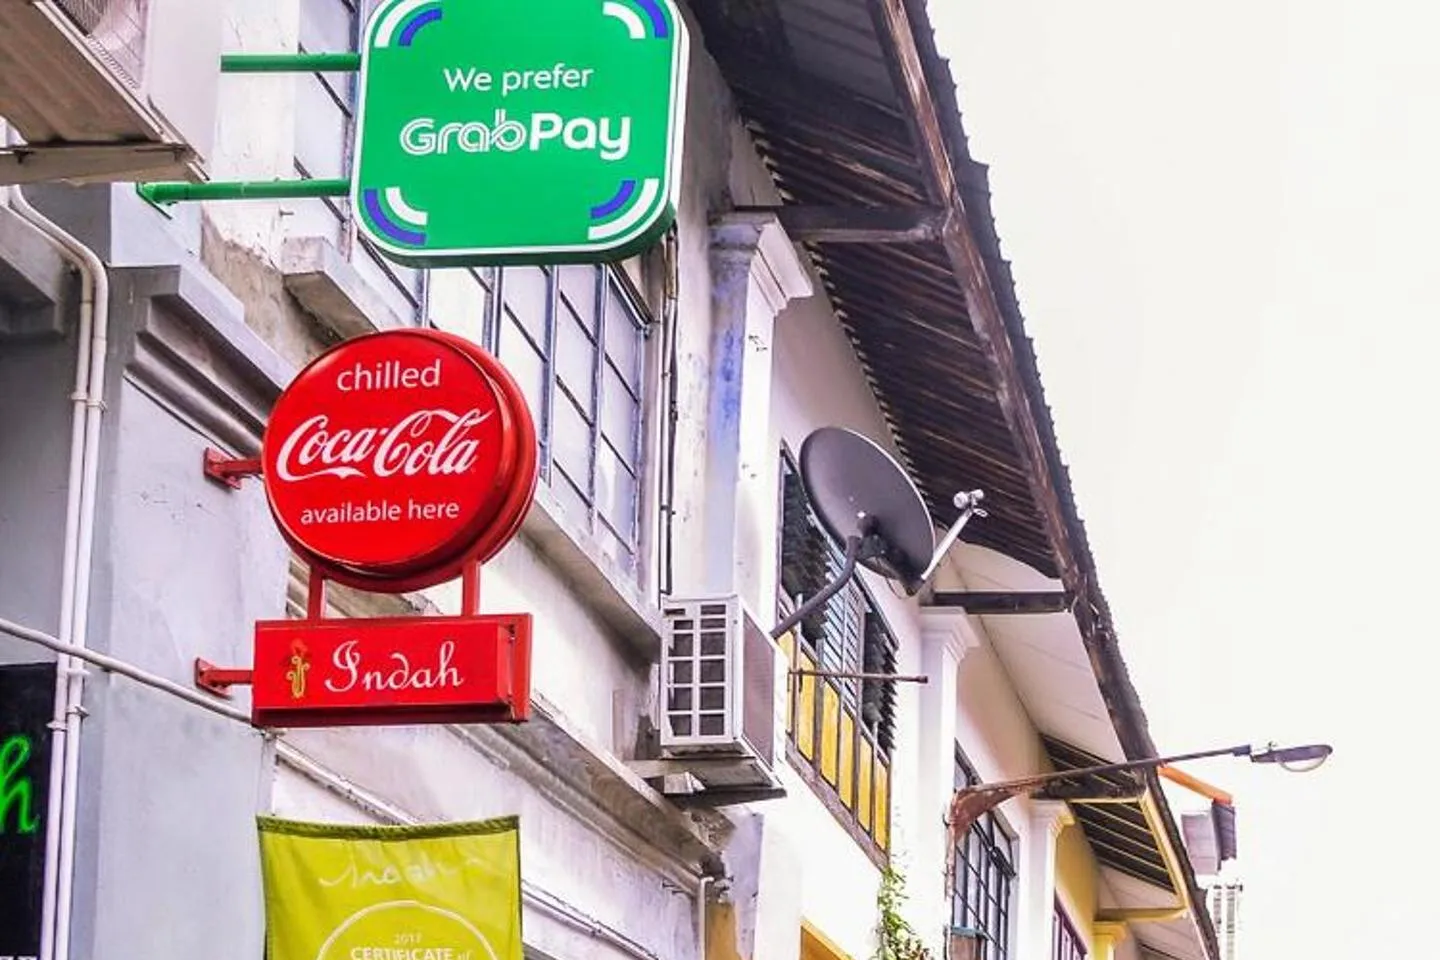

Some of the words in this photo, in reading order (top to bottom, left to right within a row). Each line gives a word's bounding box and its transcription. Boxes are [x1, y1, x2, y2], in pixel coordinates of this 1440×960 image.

[443, 67, 493, 92] We
[502, 62, 594, 97] prefer
[399, 108, 631, 161] GrabPay
[336, 359, 441, 392] chilled
[276, 407, 494, 482] Coca-Cola
[299, 498, 401, 525] available
[407, 499, 460, 521] here
[324, 640, 463, 693] Indah
